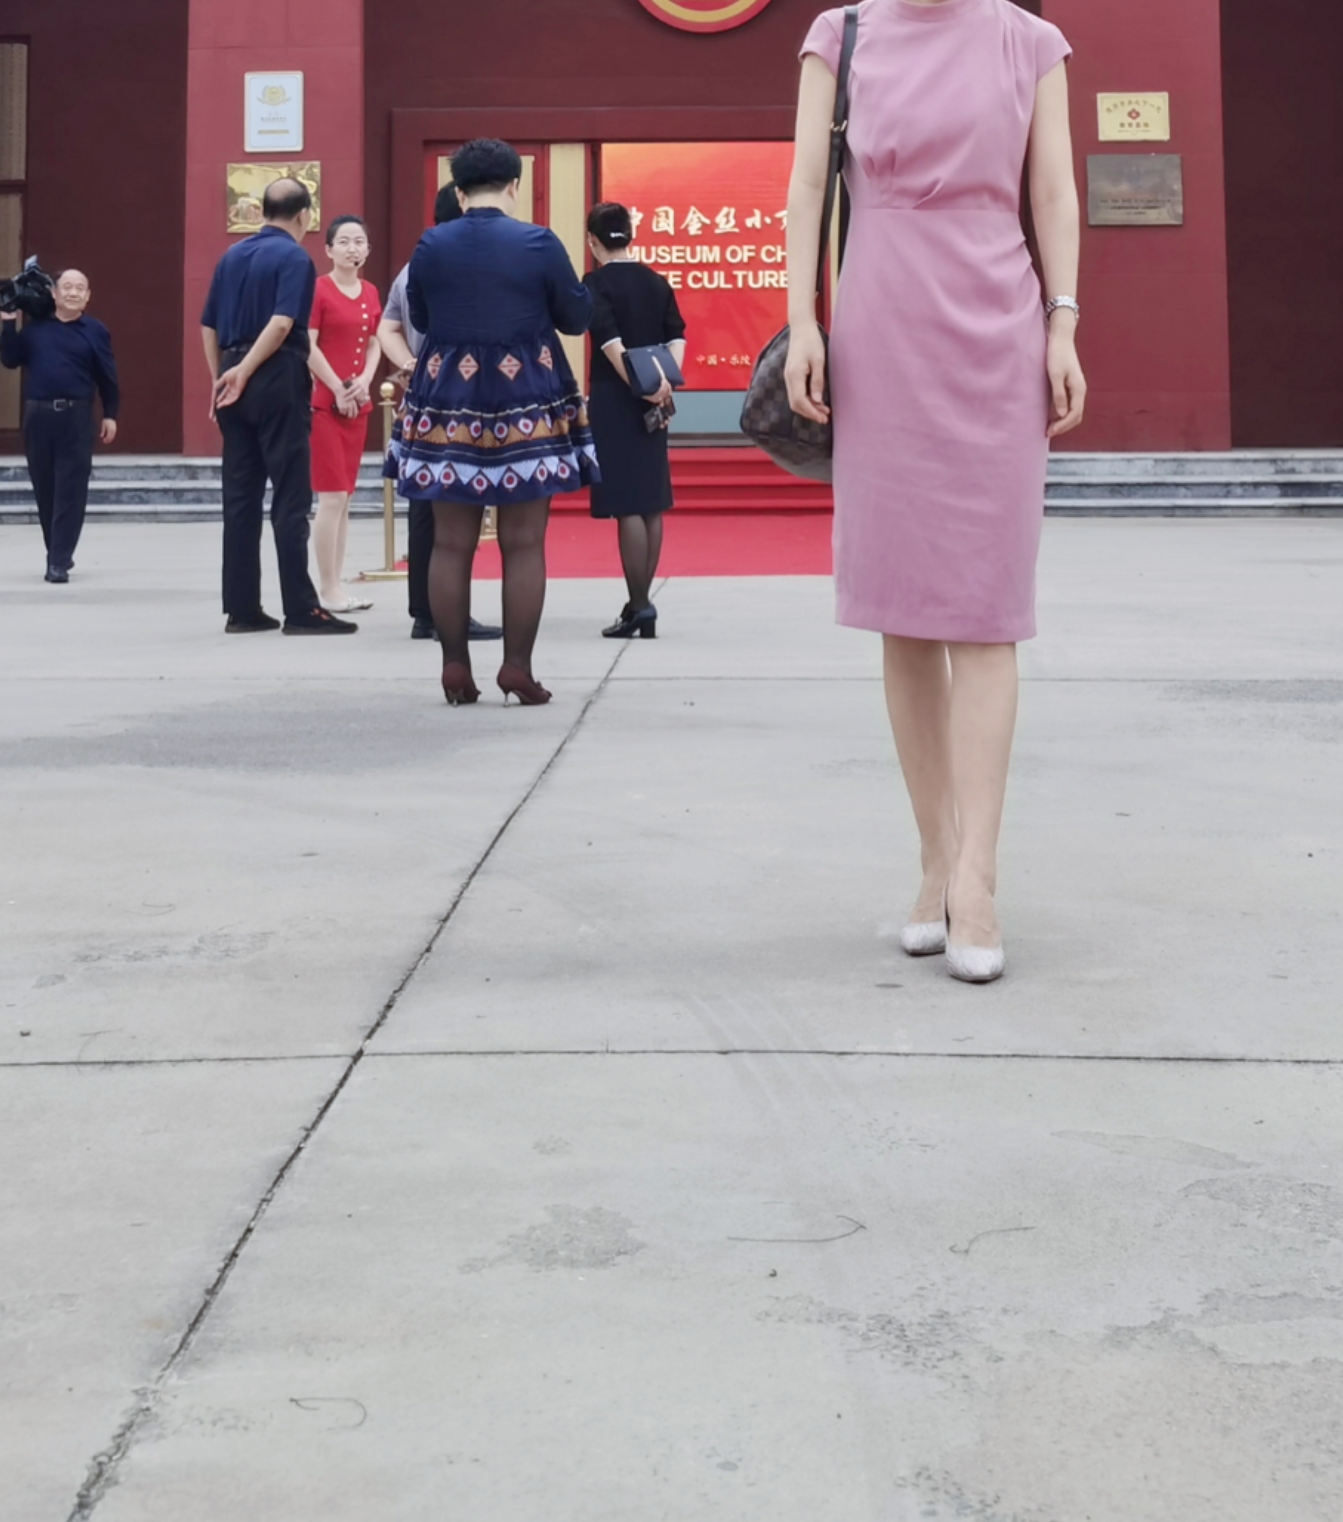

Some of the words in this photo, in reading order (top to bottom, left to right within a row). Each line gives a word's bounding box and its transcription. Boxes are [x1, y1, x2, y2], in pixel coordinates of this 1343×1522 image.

[625, 245, 720, 264] MUSEUM
[726, 245, 756, 264] OF
[687, 270, 788, 289] CULTURE
